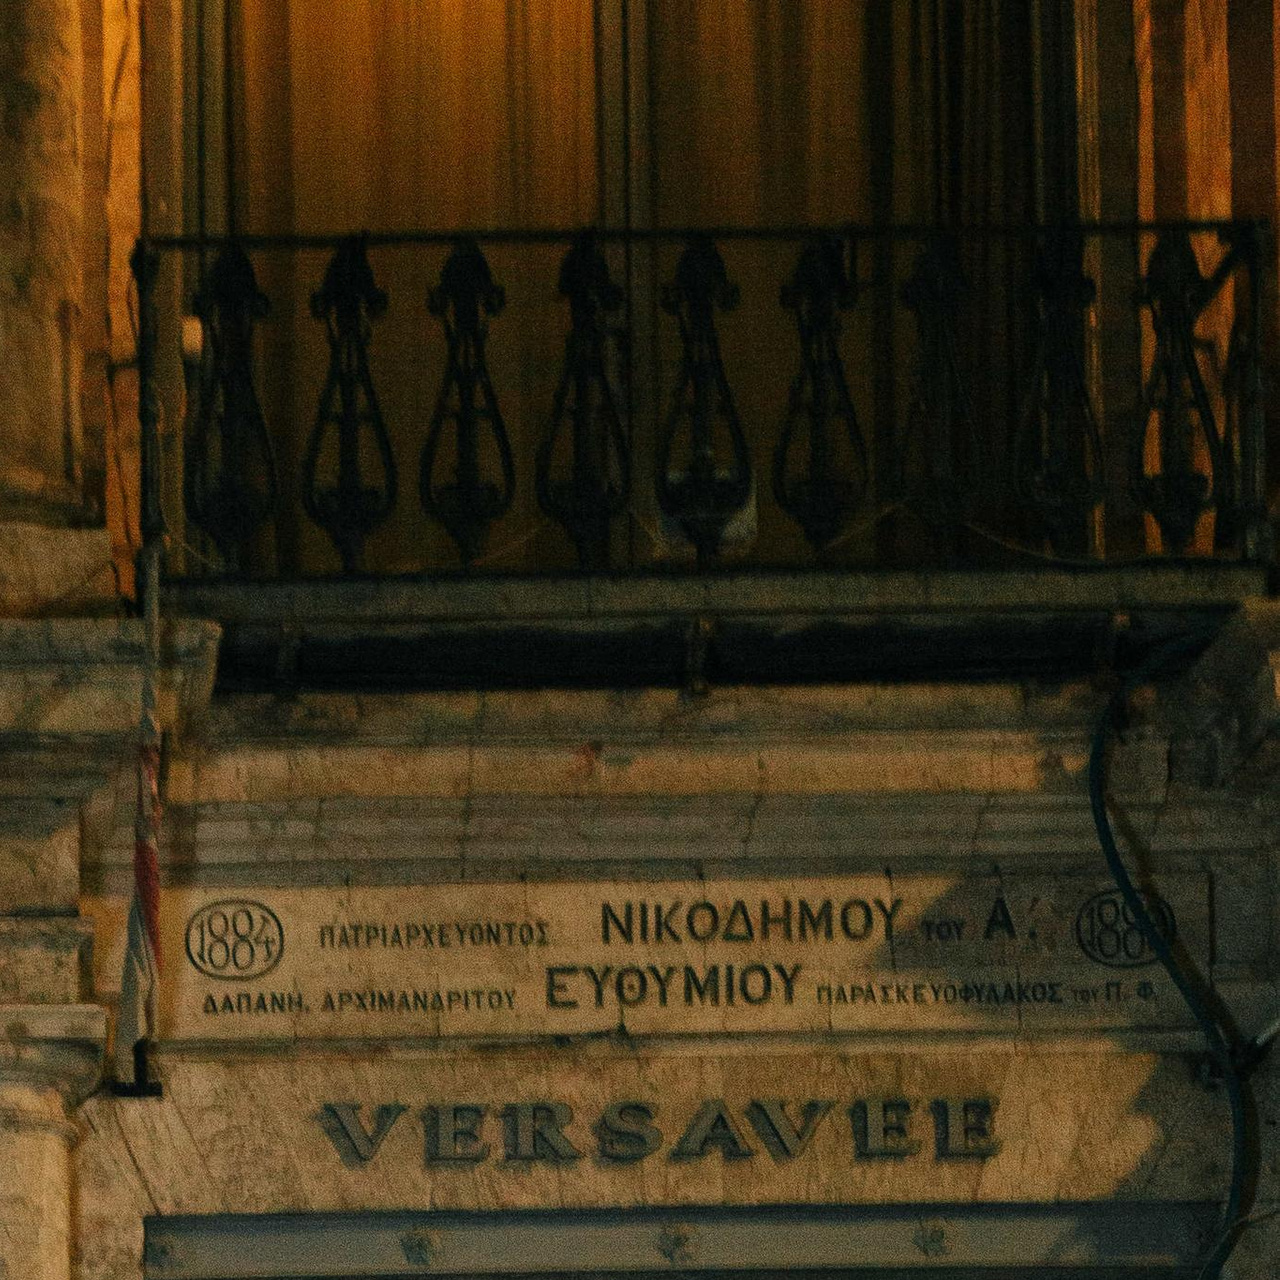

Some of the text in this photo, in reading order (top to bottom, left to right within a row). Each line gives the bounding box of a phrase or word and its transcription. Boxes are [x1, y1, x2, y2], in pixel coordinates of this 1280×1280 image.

[196, 908, 276, 970] 1884
[320, 920, 550, 950] ΠΑΤΡΙΑΡΧΕΥΟΝΤΟΣ
[601, 898, 904, 945] ΝΙΚΟΔΗΜΟΥ
[321, 988, 517, 1014] ΑΡΧΙΜΑΝΔΡΙΤΟΥ
[545, 963, 804, 1010] ΕΥΘΥΜΙΟΥ
[816, 982, 1064, 1006] ΠΑΡΑΣΚΕΥΟΦΥΛΑΚΟΣ
[320, 1098, 1002, 1170] VERSAVEE
